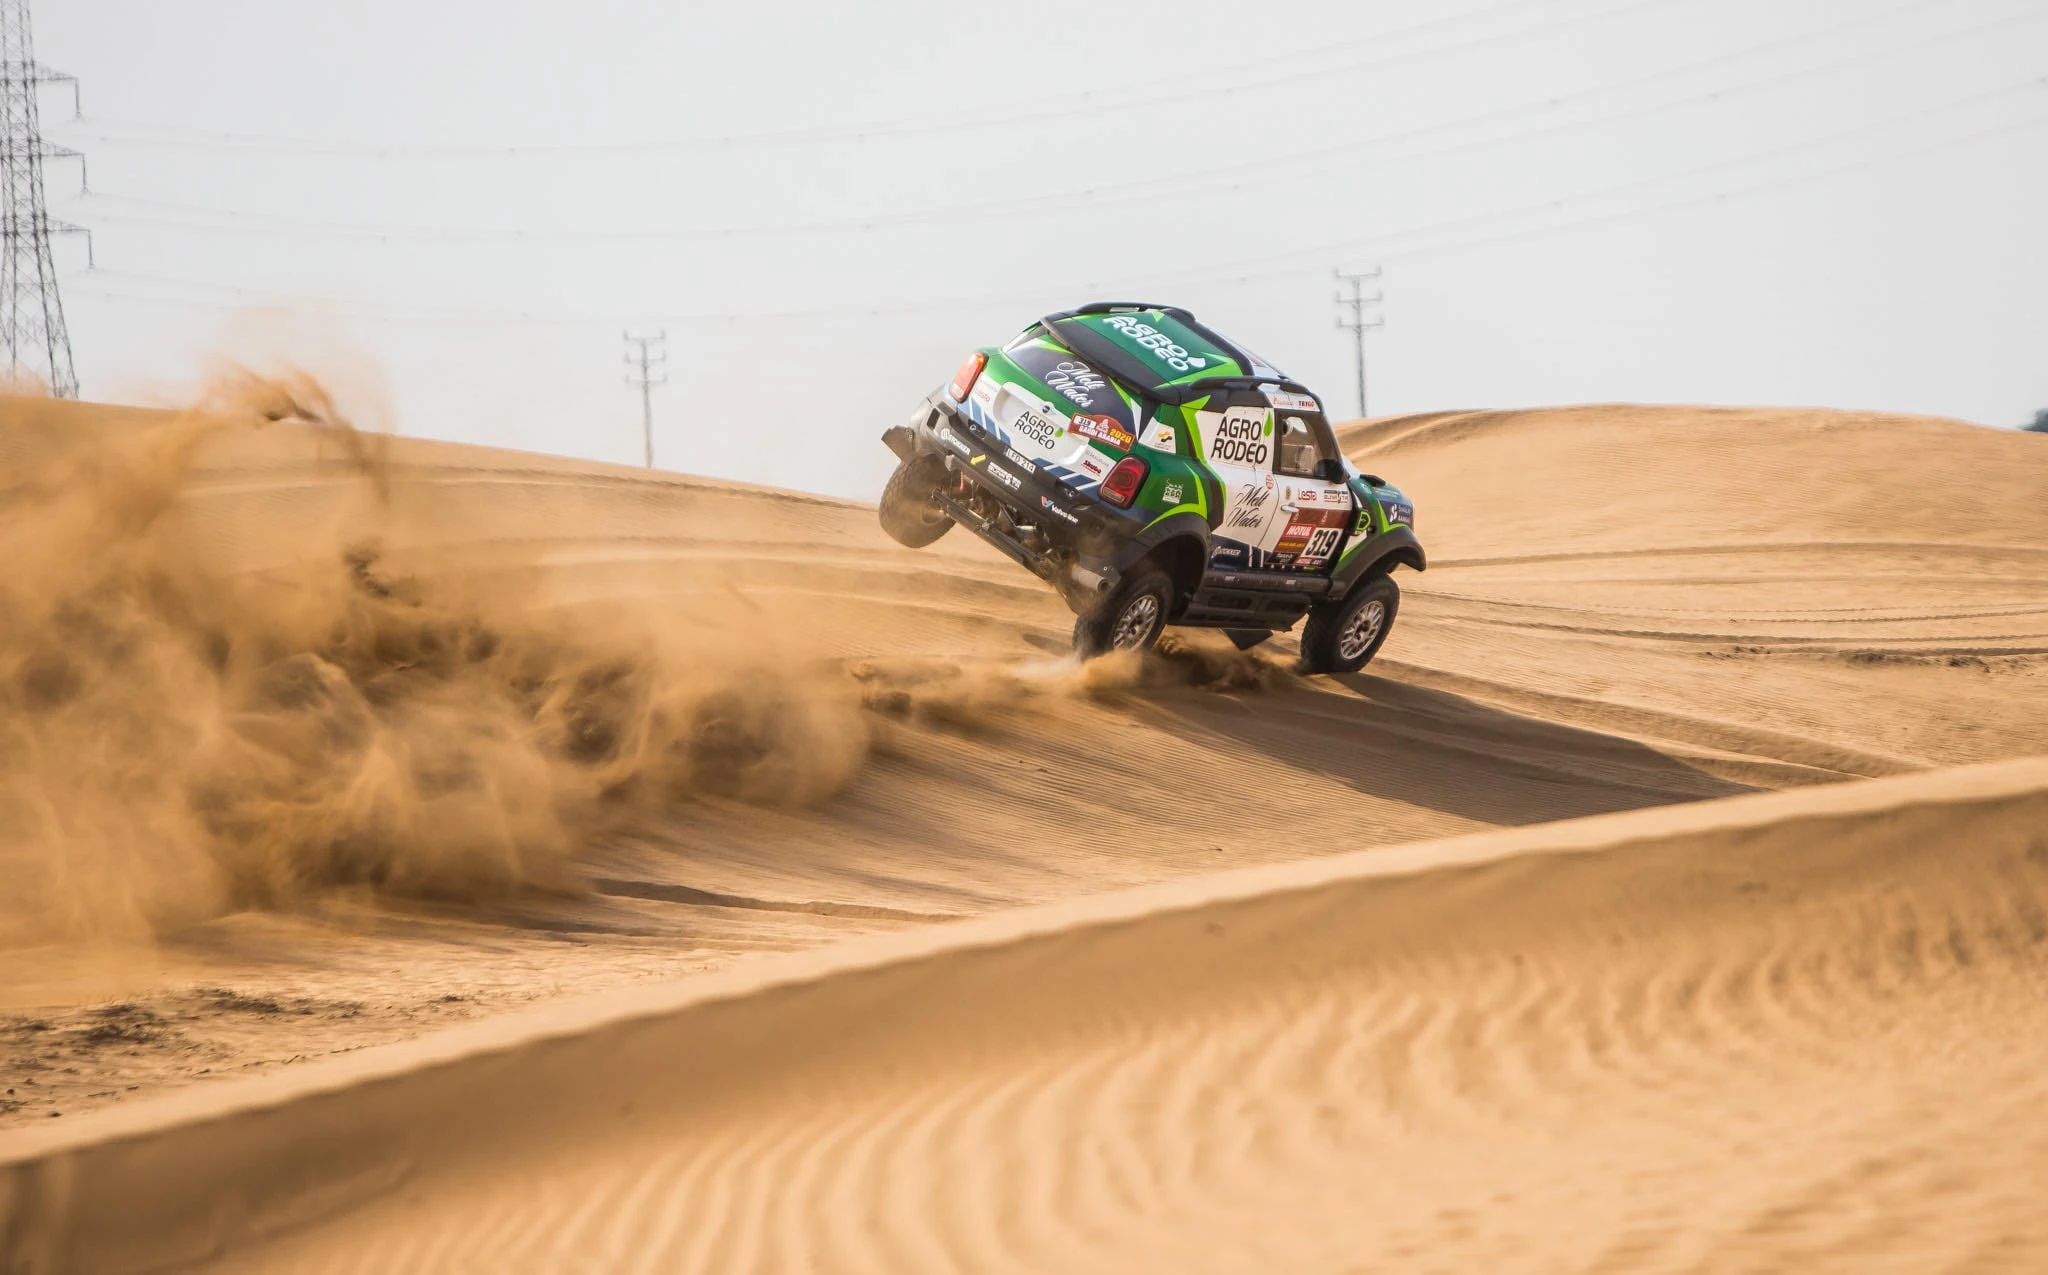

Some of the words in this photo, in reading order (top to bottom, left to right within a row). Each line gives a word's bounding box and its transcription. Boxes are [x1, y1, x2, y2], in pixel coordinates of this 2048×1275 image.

[1103, 318, 1188, 371] RODEO
[1115, 316, 1188, 357] AGRO
[1045, 370, 1094, 407] Water
[1057, 361, 1105, 389] Melt
[1014, 419, 1055, 449] RODEO
[1020, 411, 1054, 436] AGRO
[1109, 428, 1132, 443] 2020
[1216, 416, 1261, 440] AGRO
[1211, 438, 1267, 464] RODEO
[1232, 484, 1270, 508] Melt
[1226, 508, 1264, 528] Water
[1305, 529, 1339, 557] 319
